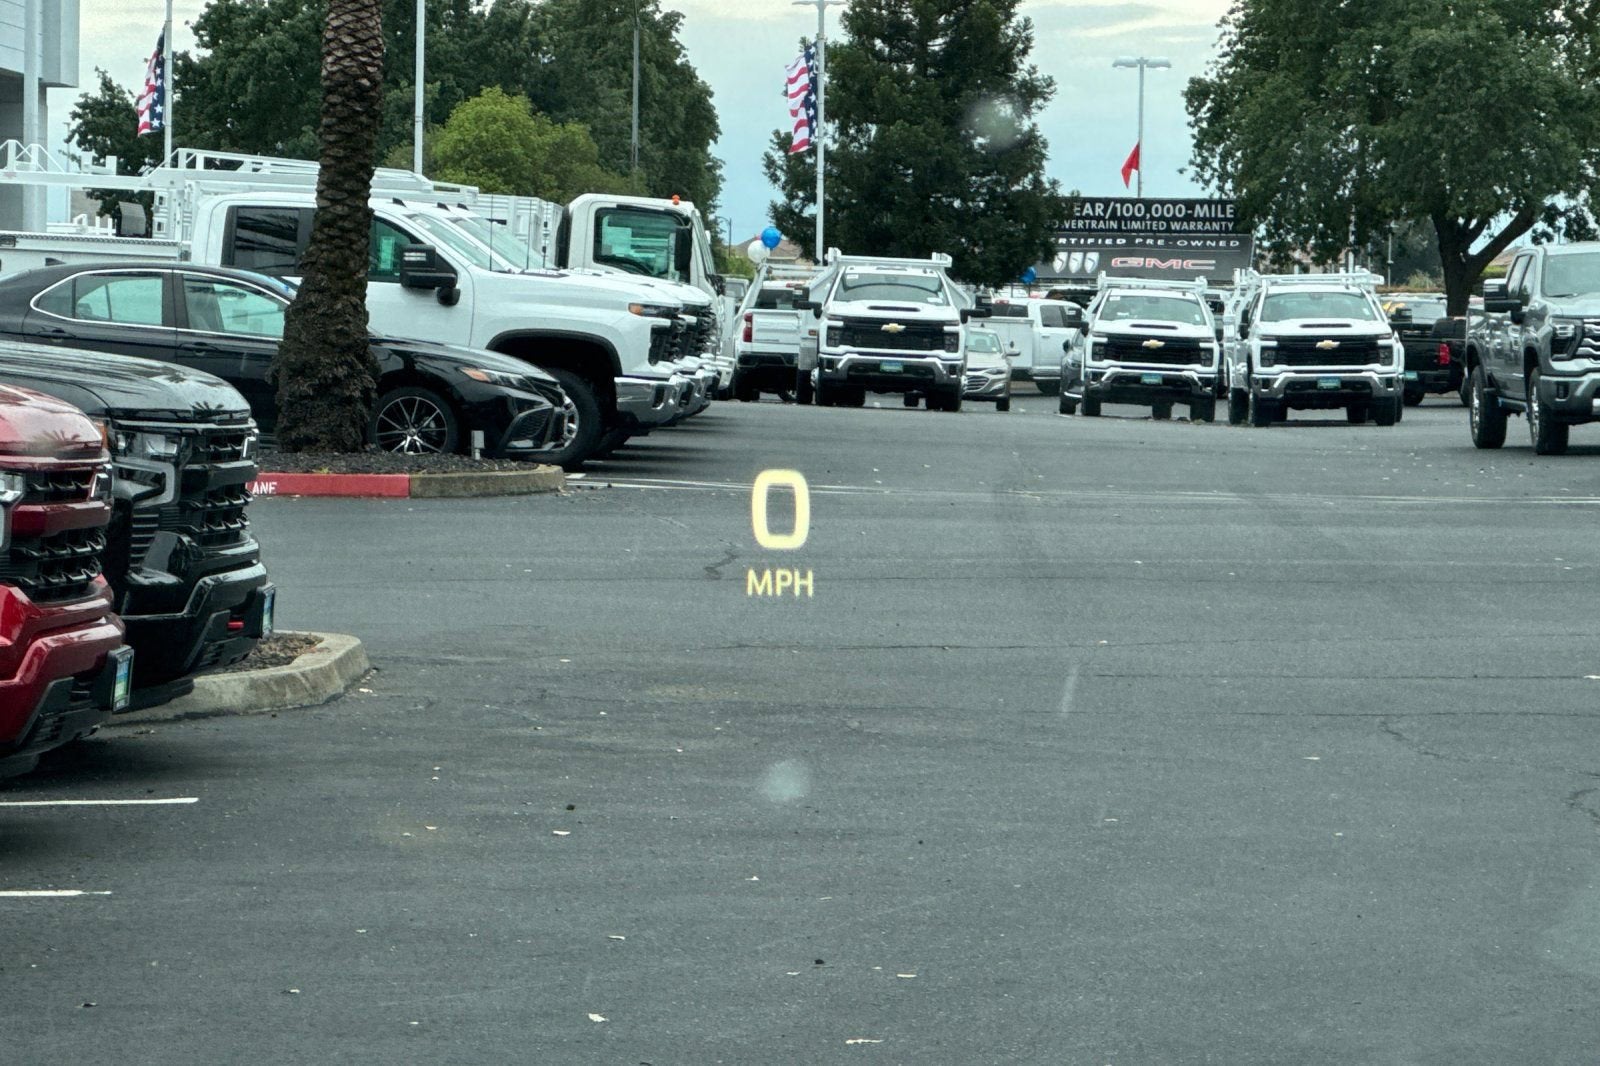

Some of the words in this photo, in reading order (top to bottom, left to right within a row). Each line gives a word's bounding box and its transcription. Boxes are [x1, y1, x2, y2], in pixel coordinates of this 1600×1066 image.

[1121, 220, 1167, 231] LIMITED
[1169, 221, 1235, 231] WARRANTY
[1135, 238, 1241, 247] PRE-OWNED
[1111, 257, 1217, 270] GMC
[752, 469, 811, 550] 0
[746, 567, 815, 598] MPH
